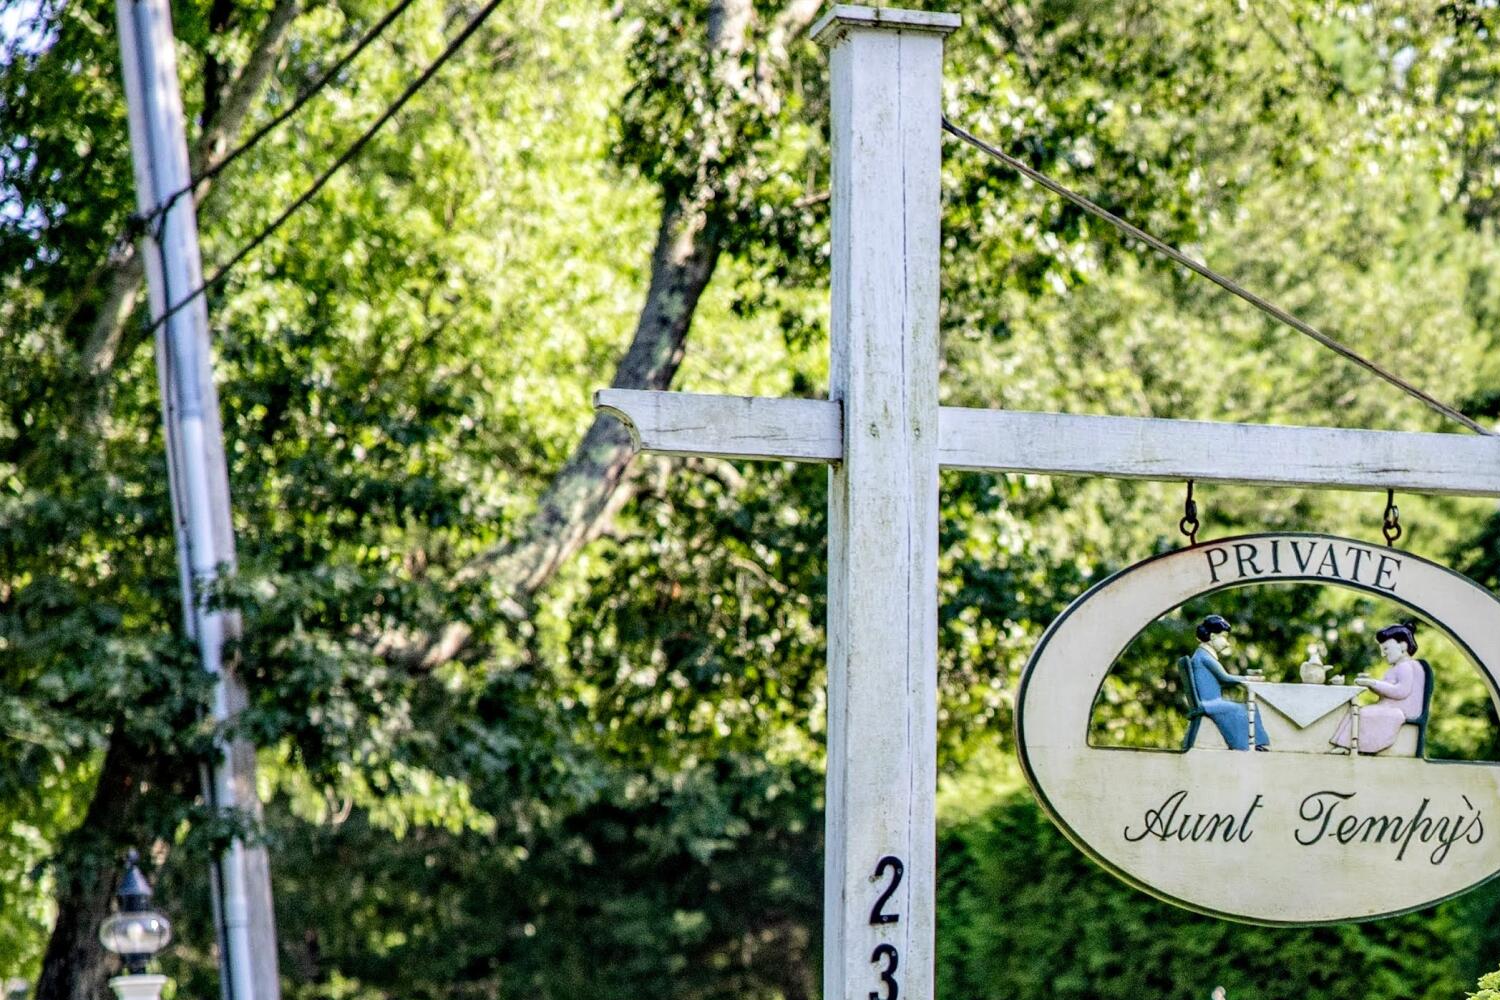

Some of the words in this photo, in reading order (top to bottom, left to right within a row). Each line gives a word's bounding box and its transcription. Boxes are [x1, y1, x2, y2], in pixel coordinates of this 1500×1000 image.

[1204, 540, 1402, 592] PRIVATE
[1124, 790, 1263, 842] Aunt
[1294, 790, 1484, 865] Tempy's
